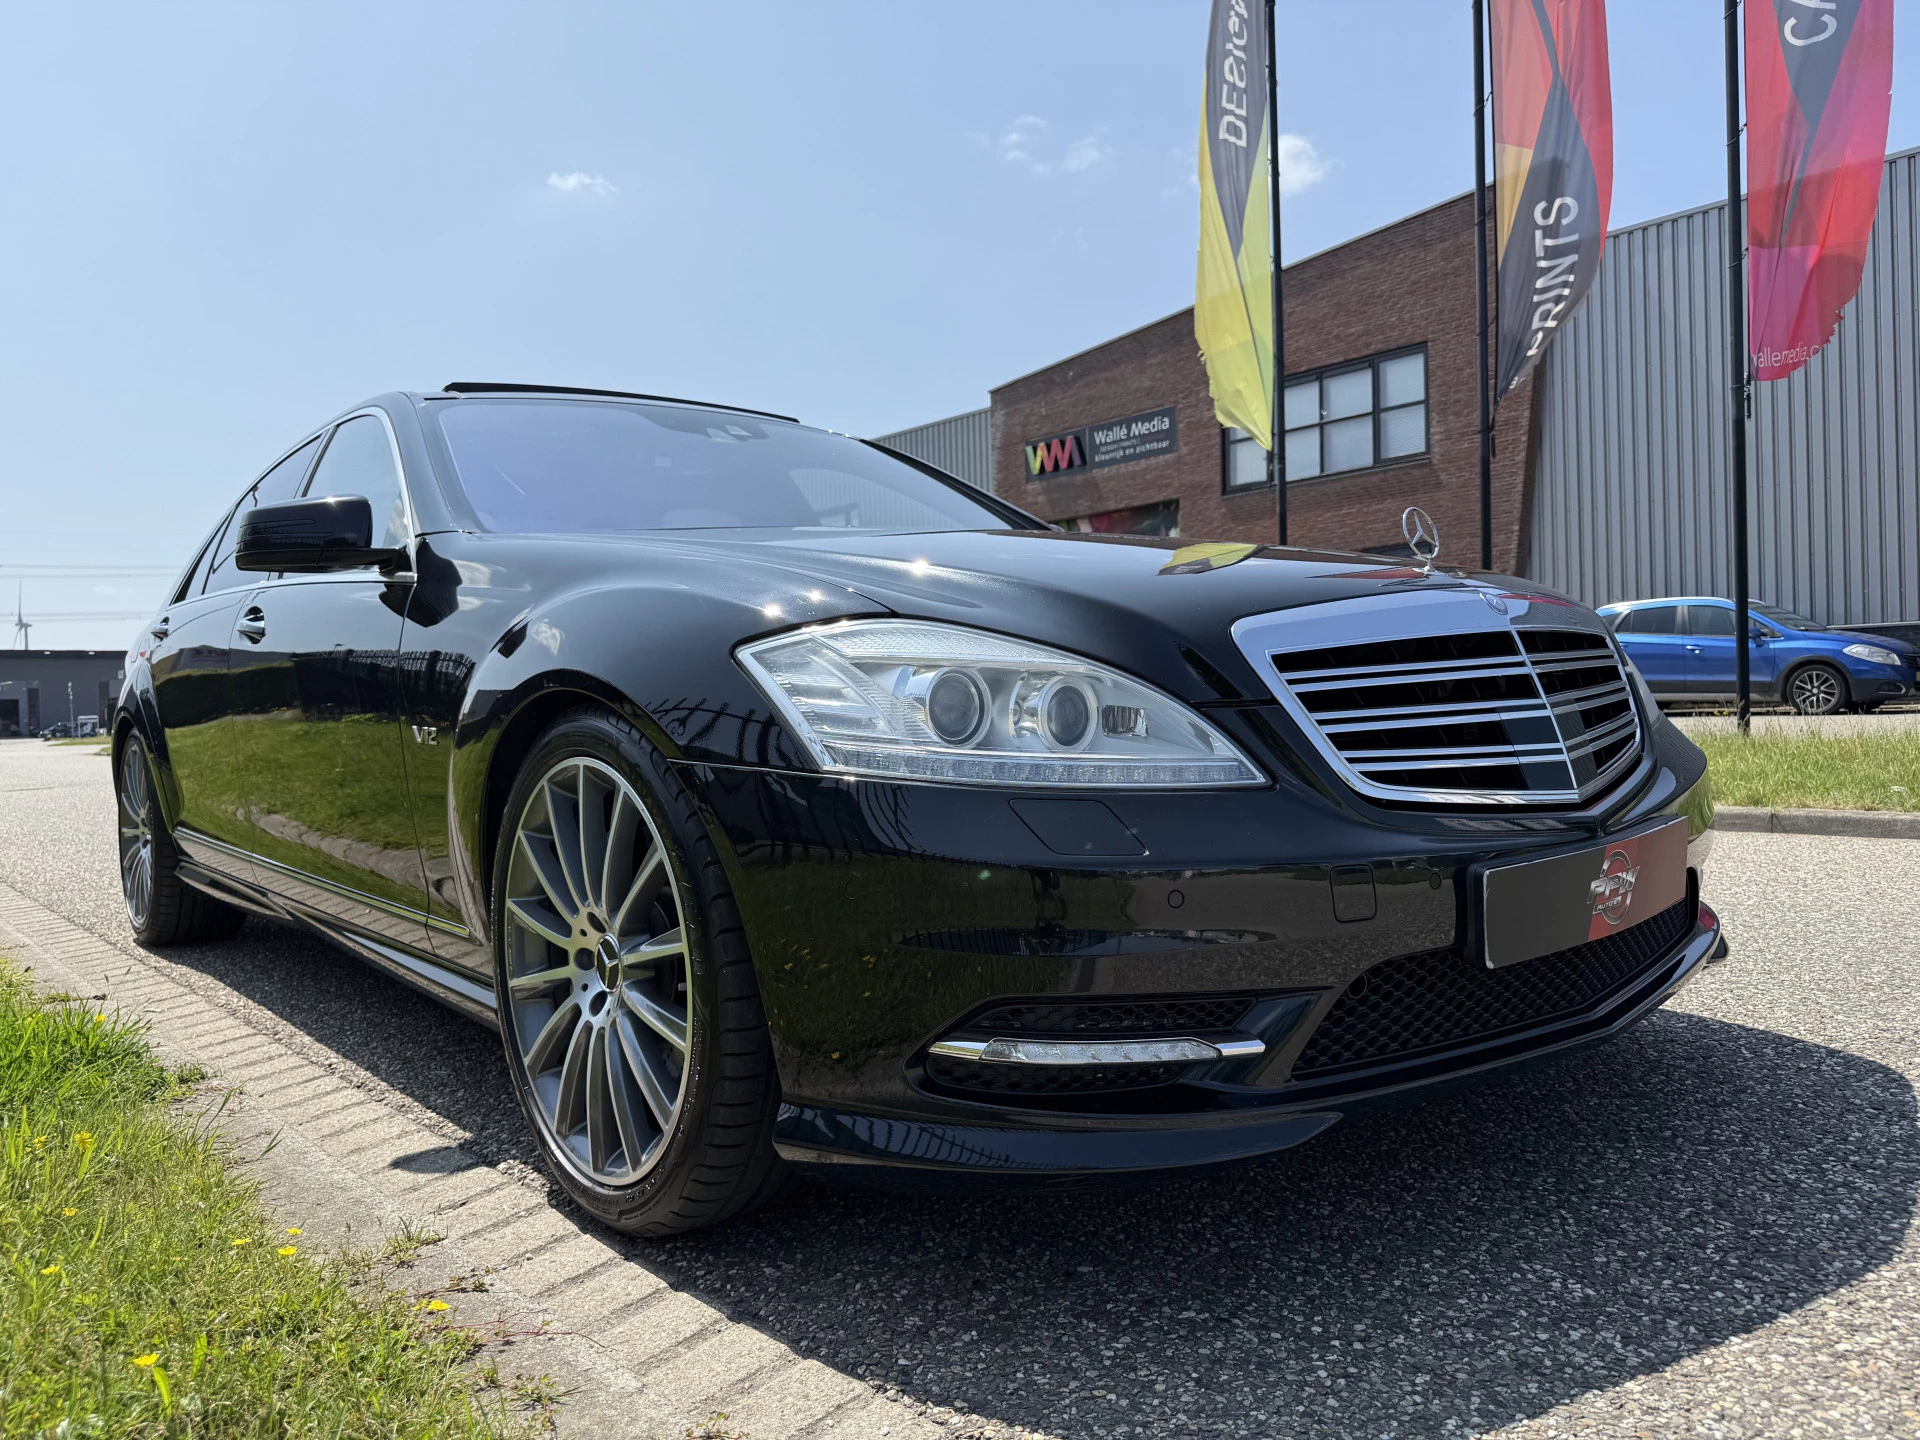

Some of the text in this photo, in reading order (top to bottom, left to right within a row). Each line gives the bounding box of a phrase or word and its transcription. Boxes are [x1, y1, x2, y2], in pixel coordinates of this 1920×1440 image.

[1094, 423, 1128, 445] Wallé
[1130, 415, 1170, 437] Media
[411, 725, 438, 745] V12
